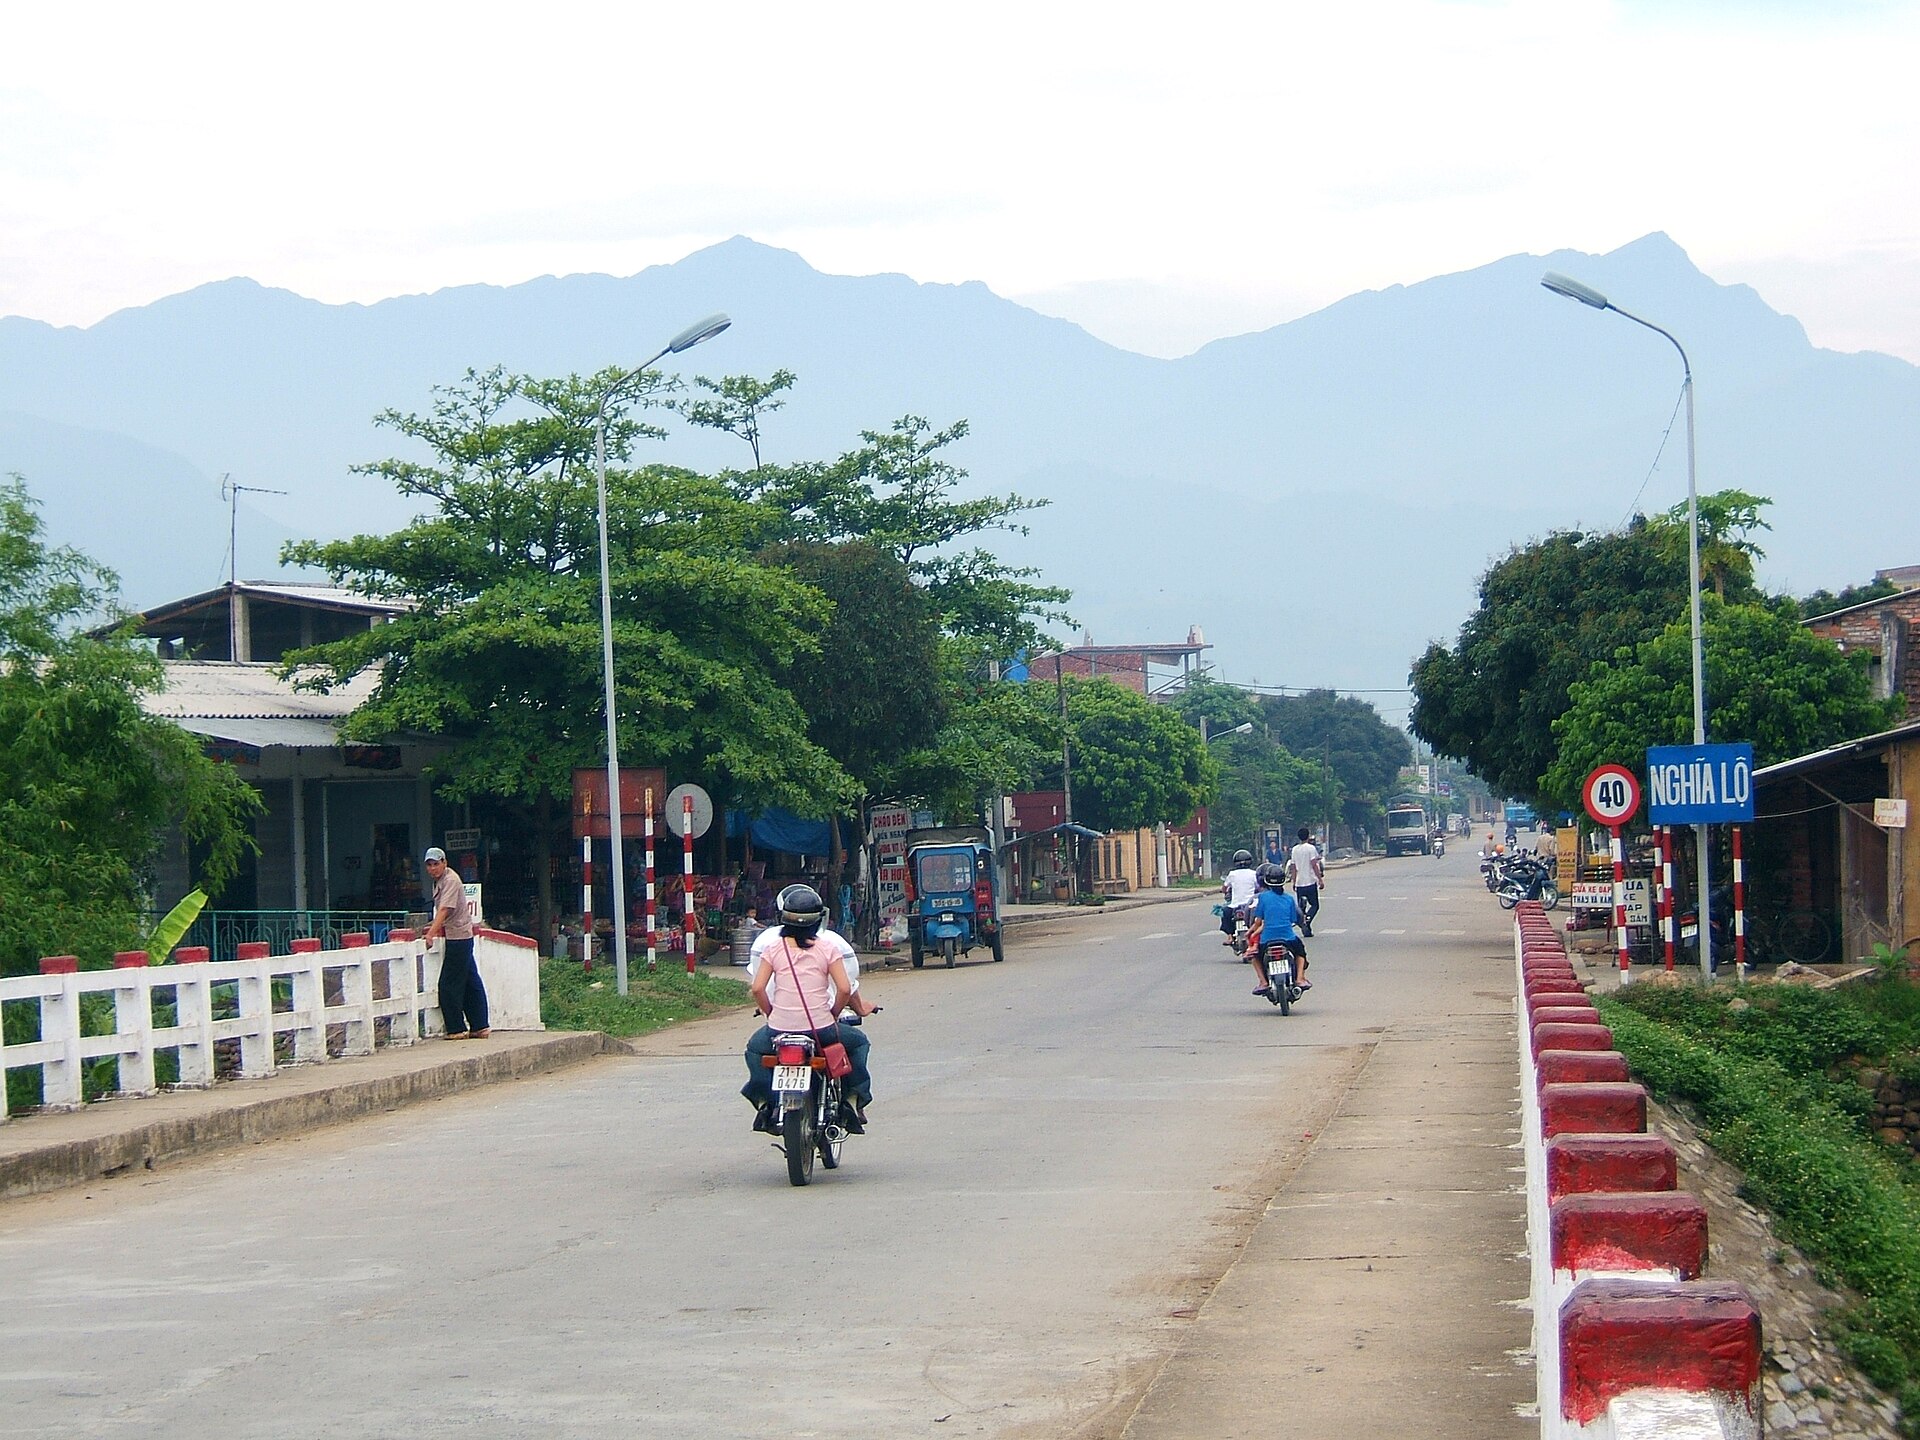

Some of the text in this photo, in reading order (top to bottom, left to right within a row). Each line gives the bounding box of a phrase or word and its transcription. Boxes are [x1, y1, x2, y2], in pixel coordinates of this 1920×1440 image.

[1650, 756, 1749, 808] NGHĨA LỘ
[1598, 780, 1625, 808] 40
[880, 882, 899, 892] KEM
[778, 1067, 806, 1077] 21-T1
[777, 1079, 805, 1089] 0476
